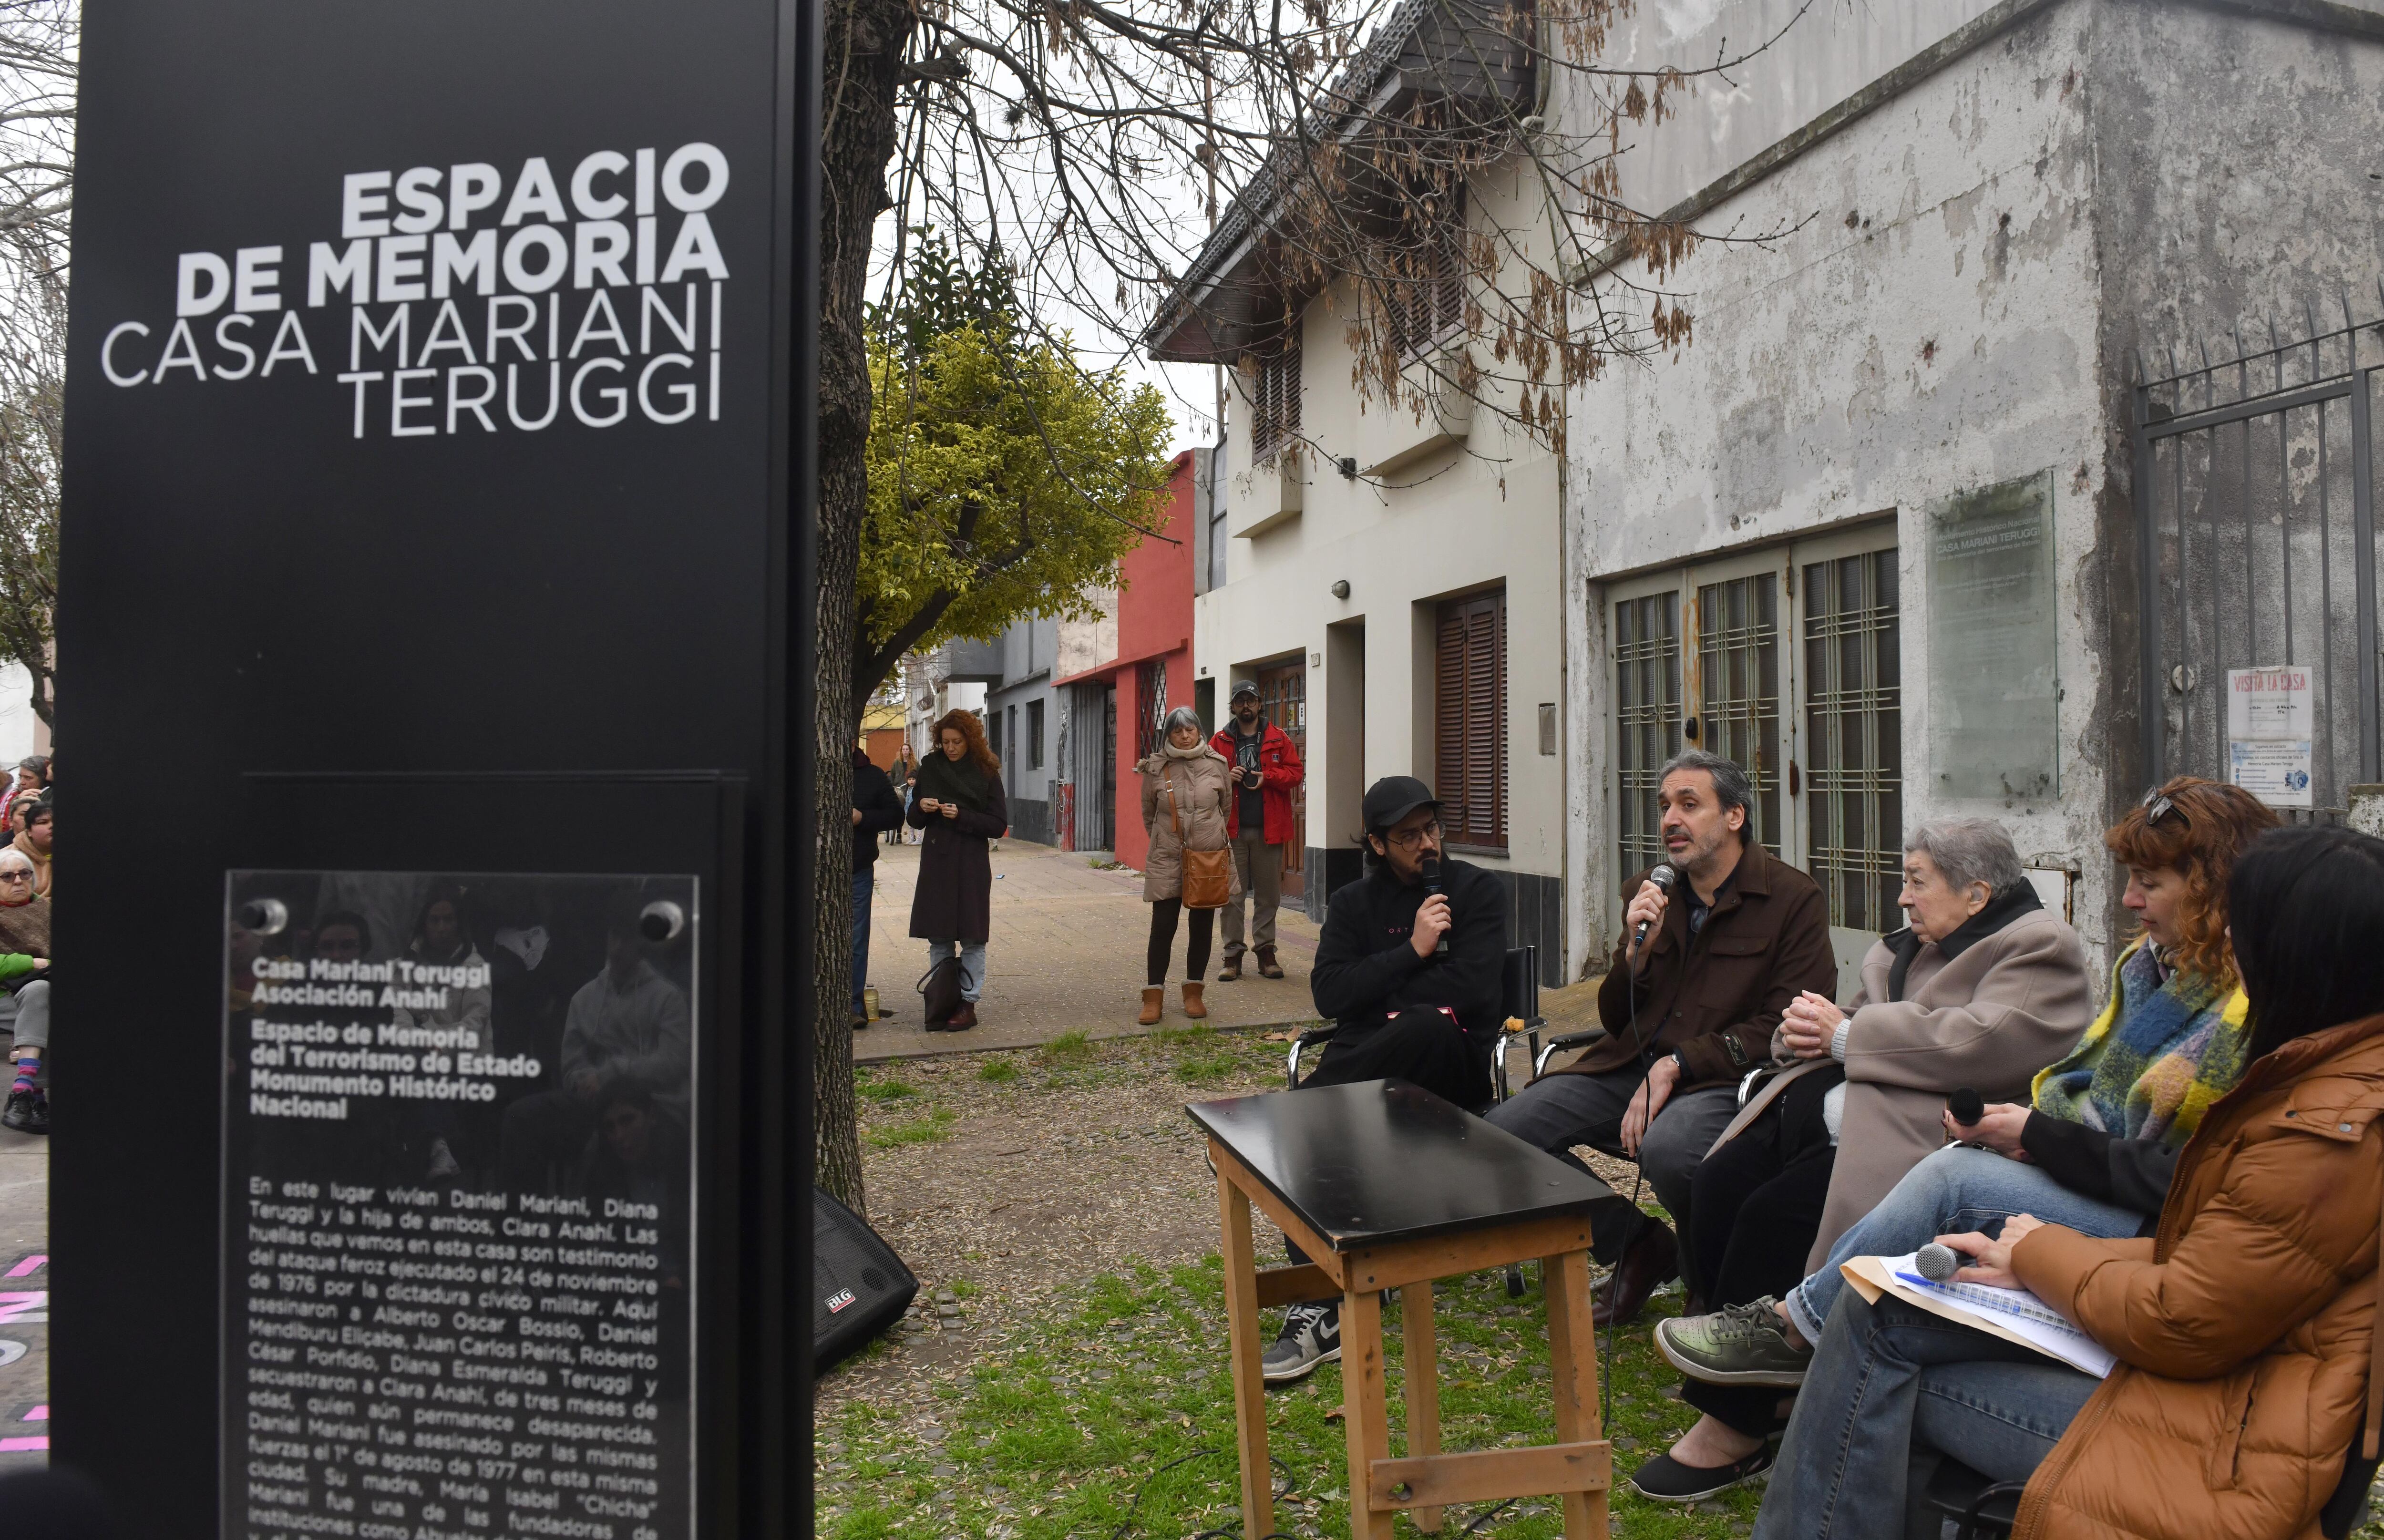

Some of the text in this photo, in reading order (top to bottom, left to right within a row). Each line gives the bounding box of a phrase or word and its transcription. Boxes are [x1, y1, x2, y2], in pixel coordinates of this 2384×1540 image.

[342, 142, 730, 238] ESPACIO
[178, 211, 730, 317] DE MEMORIA
[101, 281, 721, 388] CASA MARIANI
[338, 352, 720, 438] TERUGGI
[1936, 527, 2040, 554] CASA MARIANI TERUGGI
[2008, 516, 2040, 527] Nacional
[2268, 675, 2278, 691] LA
[2281, 673, 2306, 690] CASA
[251, 957, 491, 988] Casa Mariani Teruggi
[251, 983, 447, 1010] Asociación Anahí
[251, 1019, 479, 1049] Espacio de Memoria
[250, 1044, 540, 1077] del Terrorismo de Estado
[250, 1069, 495, 1101] Monumento Histórico
[250, 1094, 348, 1120] Nacional
[250, 1176, 271, 1195] En
[283, 1182, 319, 1198] este
[331, 1183, 374, 1204] lugar
[451, 1190, 506, 1210] Daniel
[520, 1194, 590, 1217] Mariani,
[605, 1198, 658, 1220] Diana
[249, 1200, 314, 1224] Teruggi
[321, 1210, 332, 1226] y
[339, 1208, 355, 1224] la
[362, 1209, 392, 1229] hija
[400, 1211, 423, 1229] de
[430, 1215, 494, 1236] ambos,
[503, 1217, 550, 1238] Clara
[626, 1226, 658, 1244] Las
[249, 1224, 658, 1270] huellas que vemos en esta casa son testimonio
[249, 1248, 658, 1294] del ataque feroz ejecutado el 24 de noviembre
[248, 1272, 270, 1289] de
[278, 1273, 316, 1293] 1976
[324, 1281, 354, 1297] por
[362, 1281, 378, 1298] la
[386, 1283, 470, 1306] dictadura
[613, 1299, 658, 1320] Aquí
[827, 1290, 851, 1309] BLG
[248, 1298, 338, 1318] asesinaron
[350, 1306, 361, 1321] a
[373, 1306, 440, 1328] Alberto
[453, 1311, 506, 1332] Oscar
[598, 1323, 657, 1345] Daniel
[413, 1334, 455, 1352] Juan
[460, 1336, 516, 1358] Carlos
[580, 1346, 658, 1370] Roberto
[391, 1354, 441, 1376] Diana
[453, 1359, 547, 1386] Esmeralda
[560, 1369, 632, 1396] Teruggi
[645, 1380, 657, 1397] y
